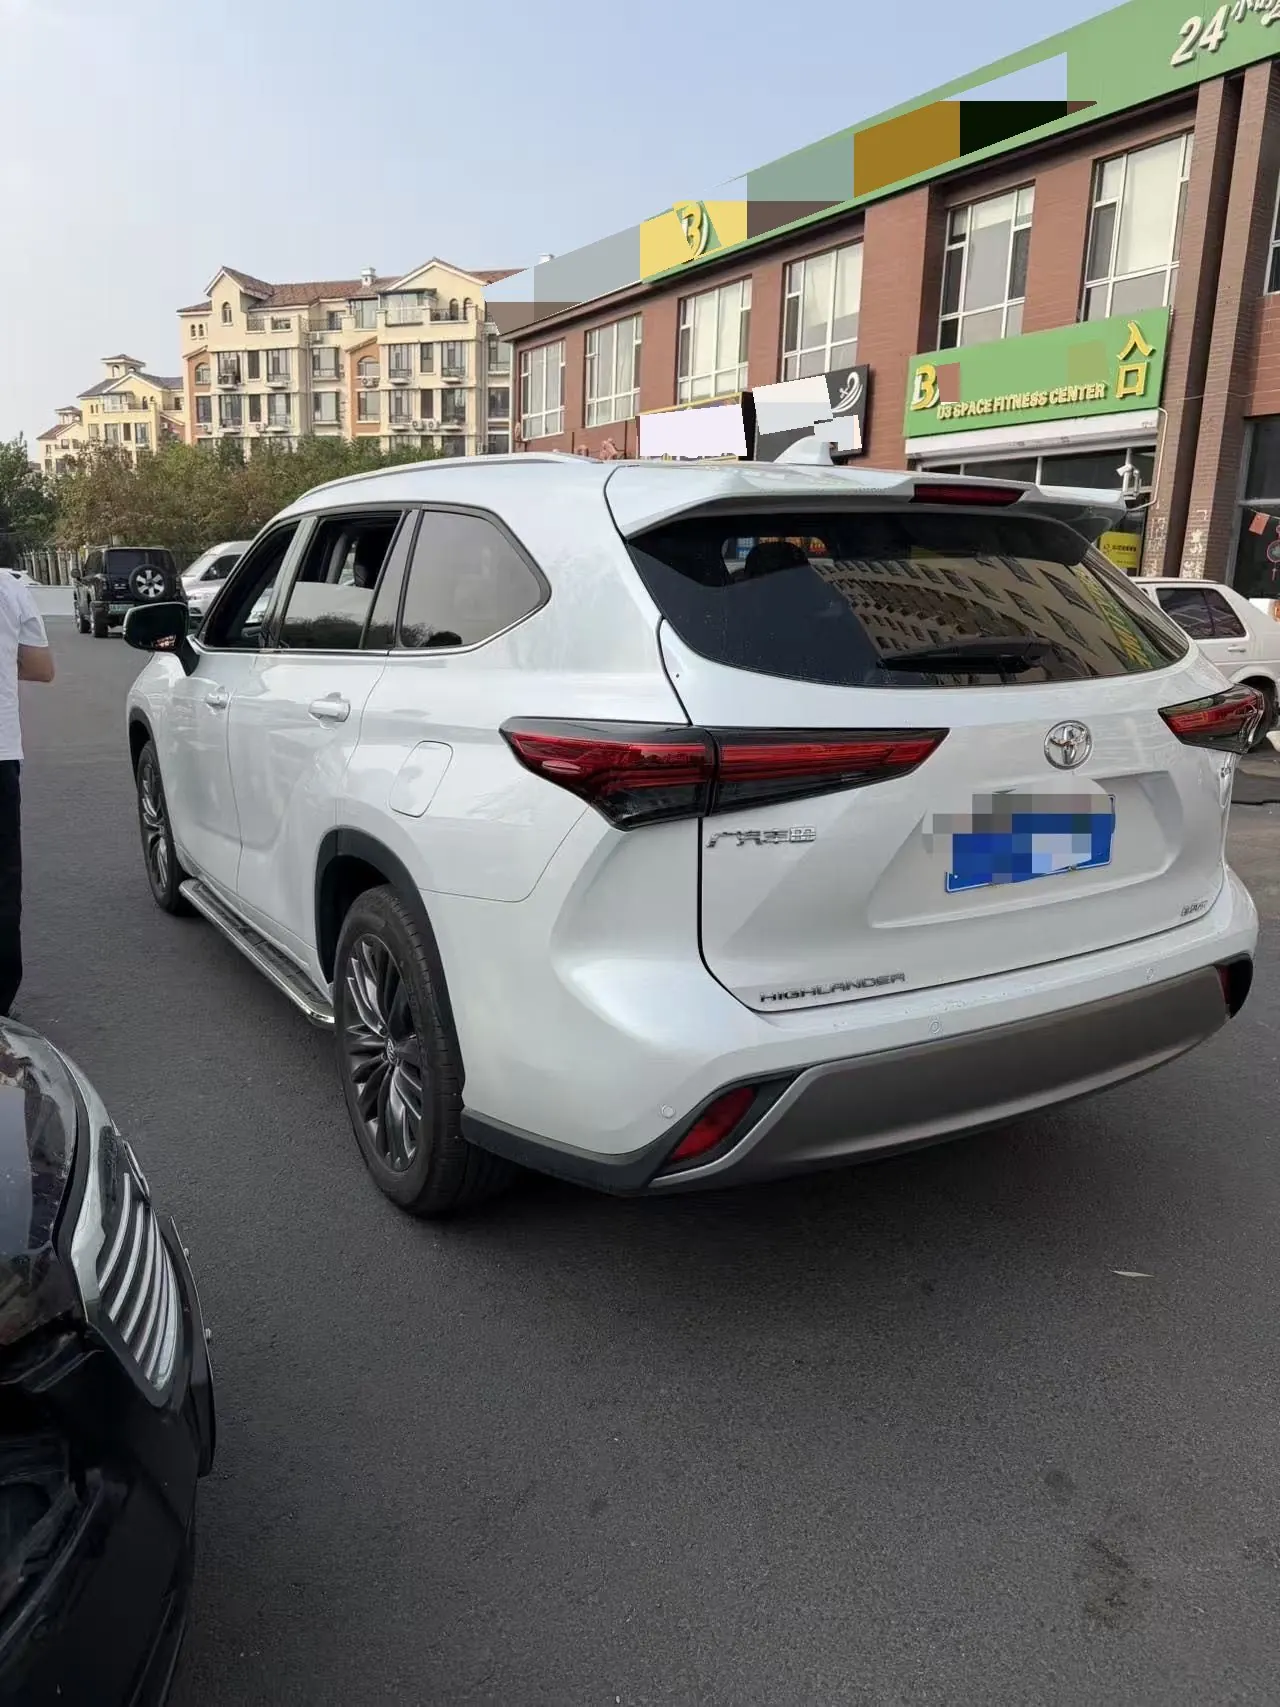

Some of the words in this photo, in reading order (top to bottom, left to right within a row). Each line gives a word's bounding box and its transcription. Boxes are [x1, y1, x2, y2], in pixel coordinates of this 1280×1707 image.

[1170, 4, 1232, 67] 24
[953, 398, 993, 418] SPACE
[993, 390, 1049, 412] FITNESS
[1049, 382, 1107, 405] CENTER
[760, 972, 905, 1003] HIGHLANDER
